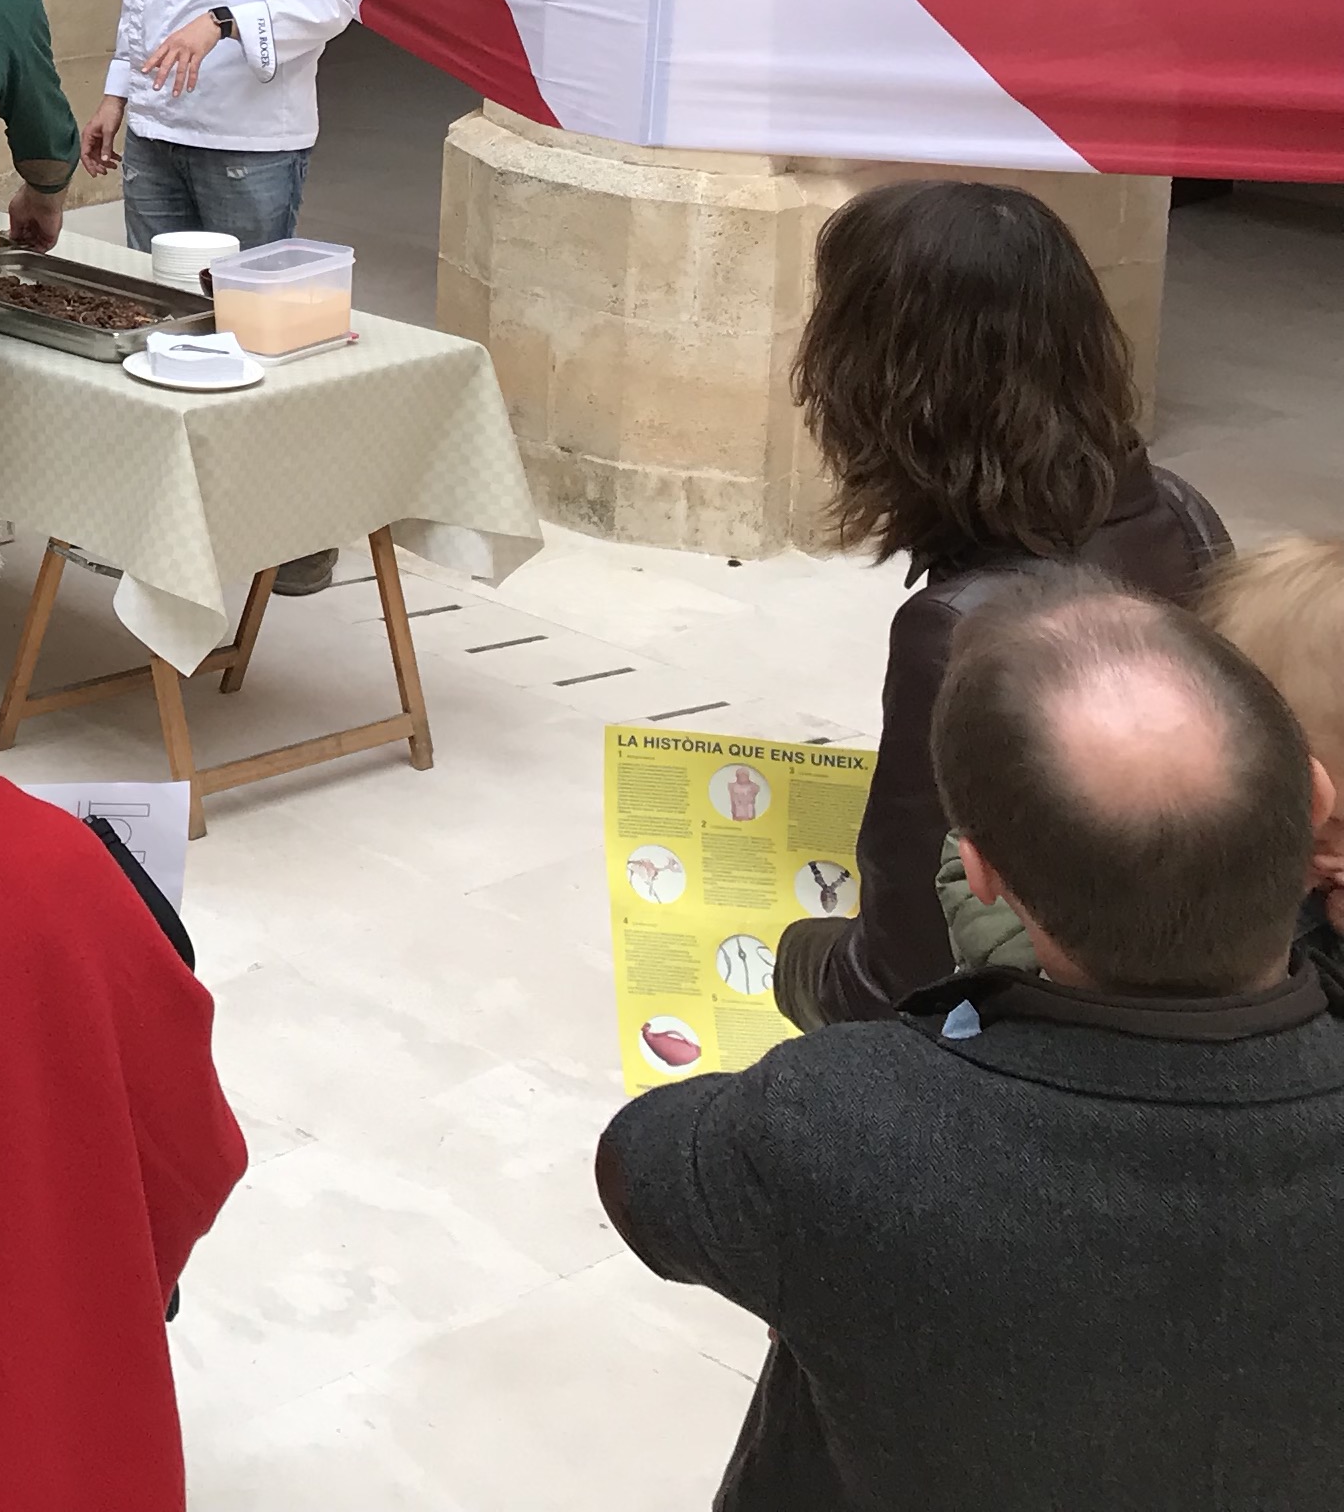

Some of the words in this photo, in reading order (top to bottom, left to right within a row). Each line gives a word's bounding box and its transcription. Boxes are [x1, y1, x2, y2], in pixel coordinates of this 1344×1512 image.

[257, 18, 266, 34] FRA
[259, 37, 270, 68] ROGER
[617, 735, 638, 747] LA
[643, 736, 723, 755] HISTÒRIA
[729, 743, 764, 760] QUE
[771, 749, 805, 764] ENS
[811, 753, 869, 770] UNEIX.
[618, 750, 622, 758] 1
[701, 820, 707, 828] 2
